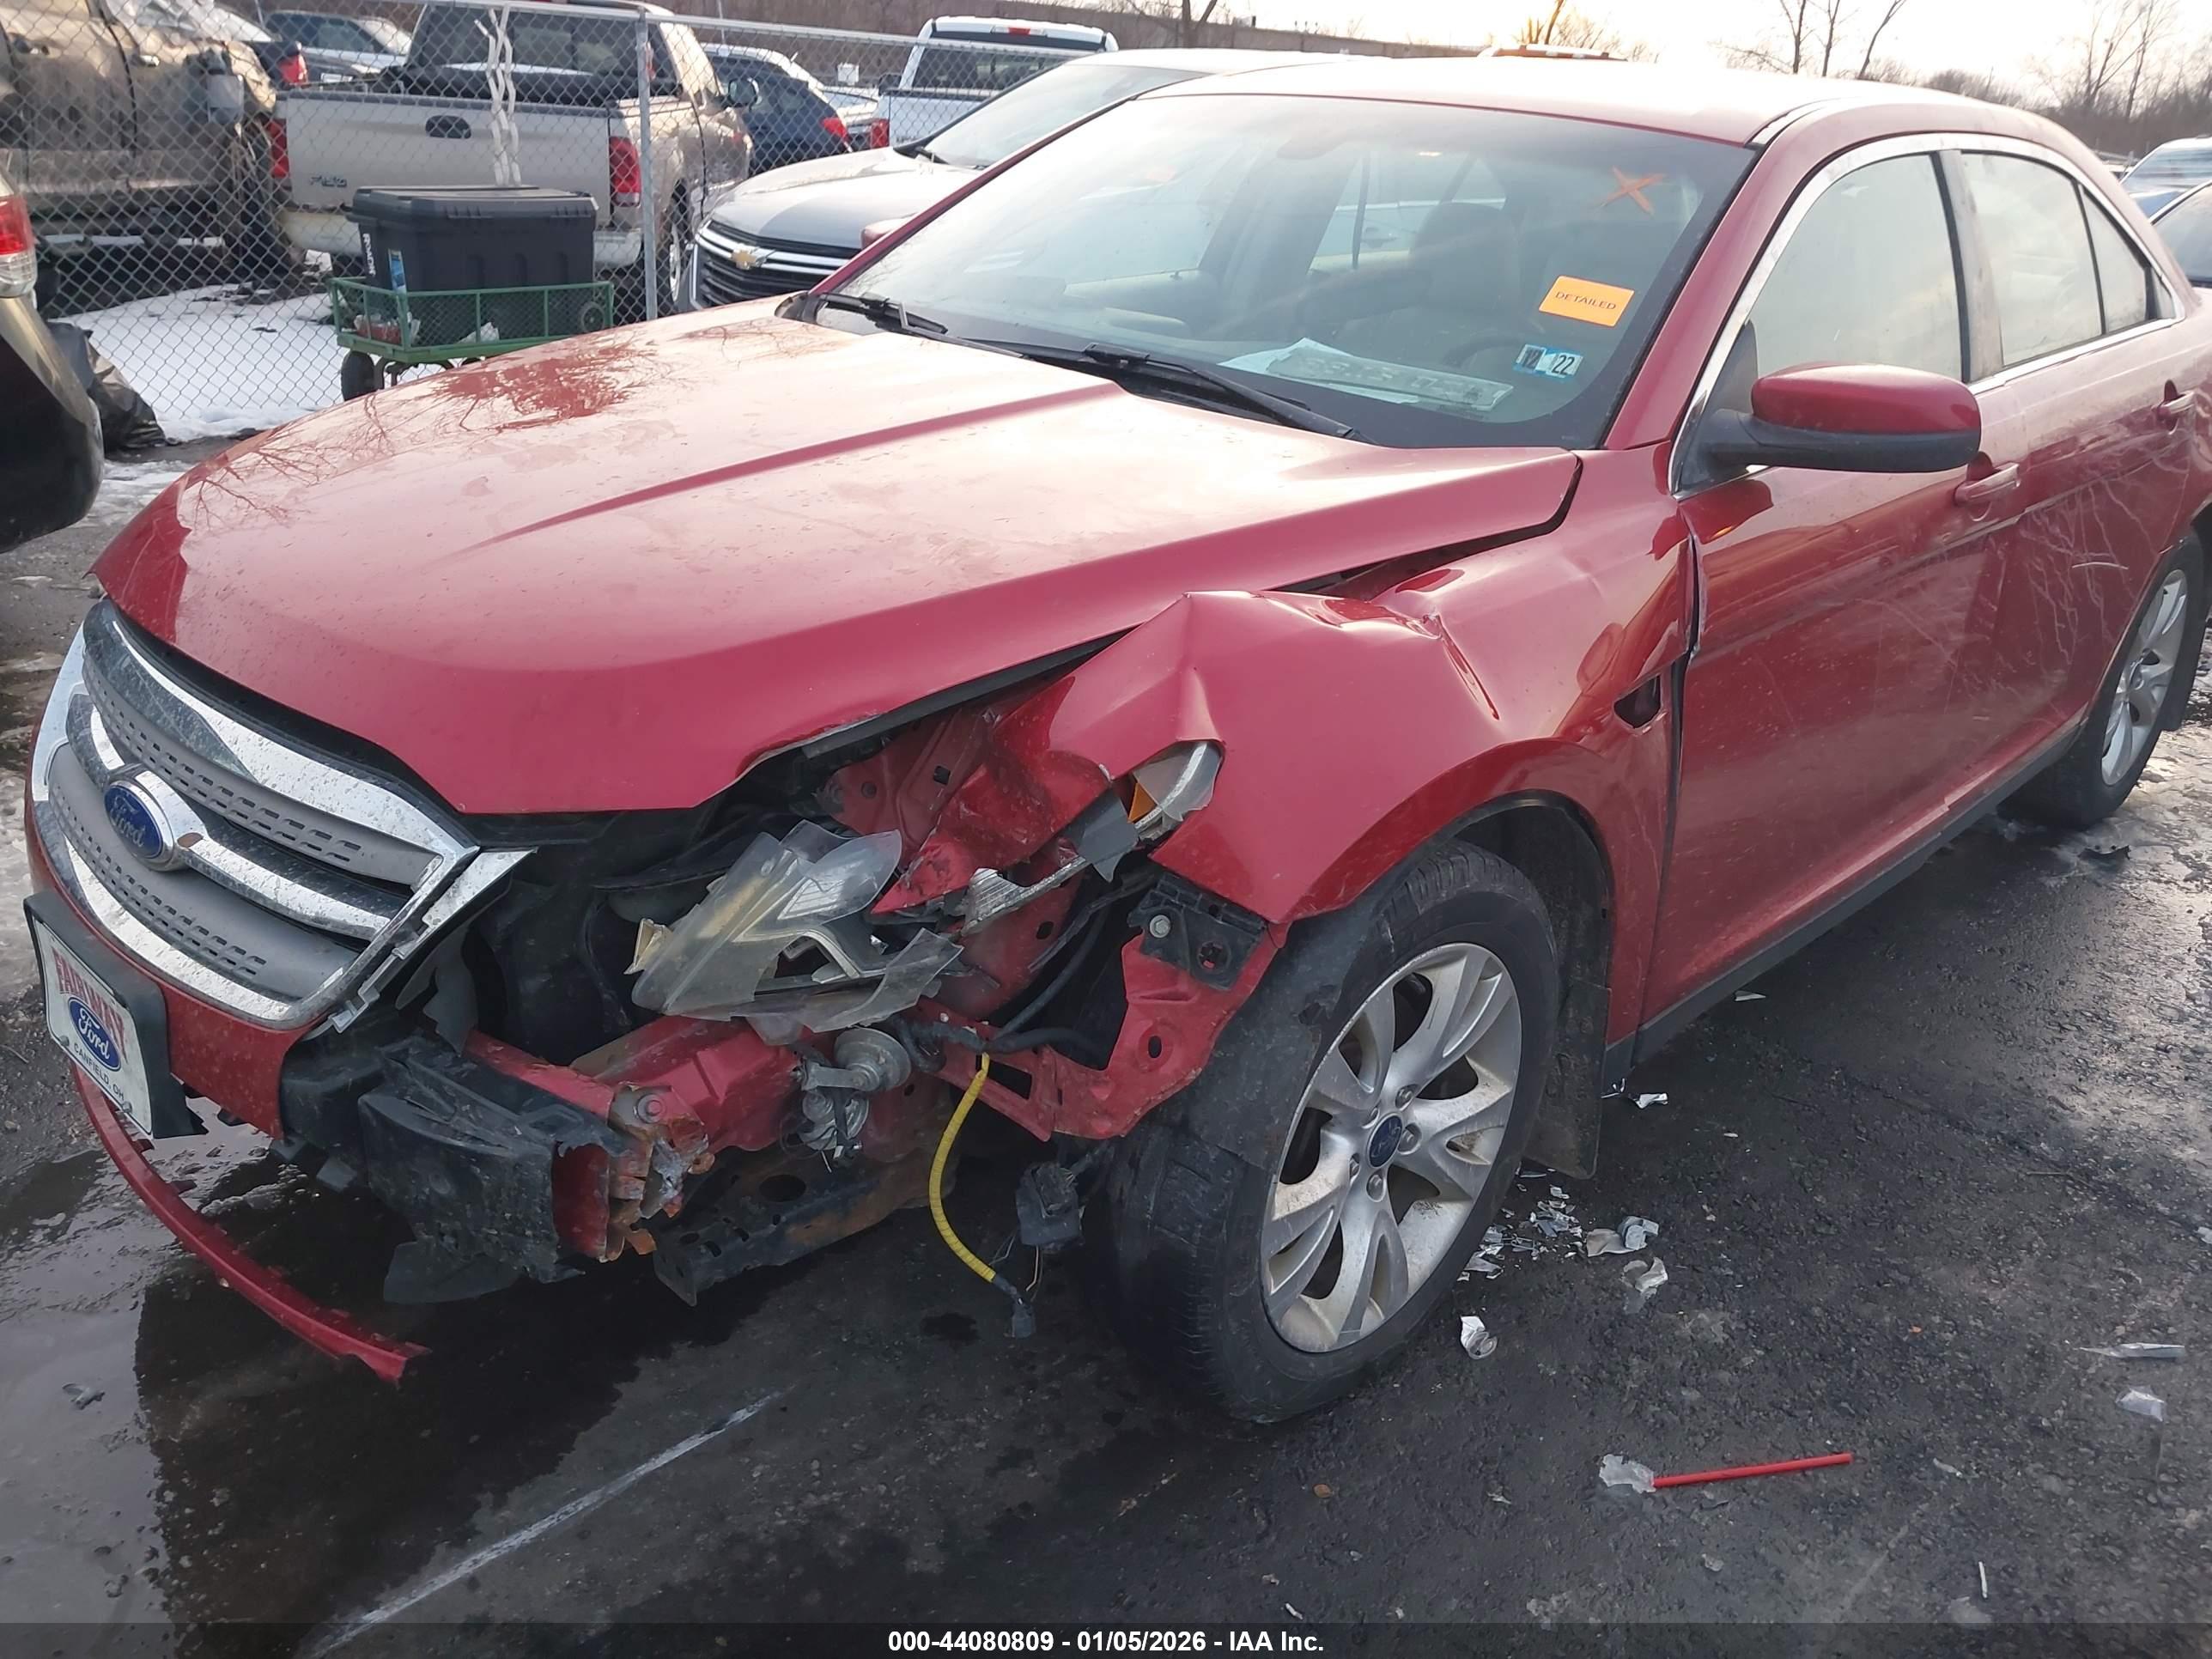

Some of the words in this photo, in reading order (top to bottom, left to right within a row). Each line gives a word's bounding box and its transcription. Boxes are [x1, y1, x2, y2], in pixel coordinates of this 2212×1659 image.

[1555, 290, 1617, 311] DETAILED
[1551, 354, 1576, 376] 22
[110, 795, 146, 848] Ford
[52, 945, 129, 1065] FAIRWAY
[78, 1007, 111, 1060] Ford
[112, 1083, 125, 1101] OH
